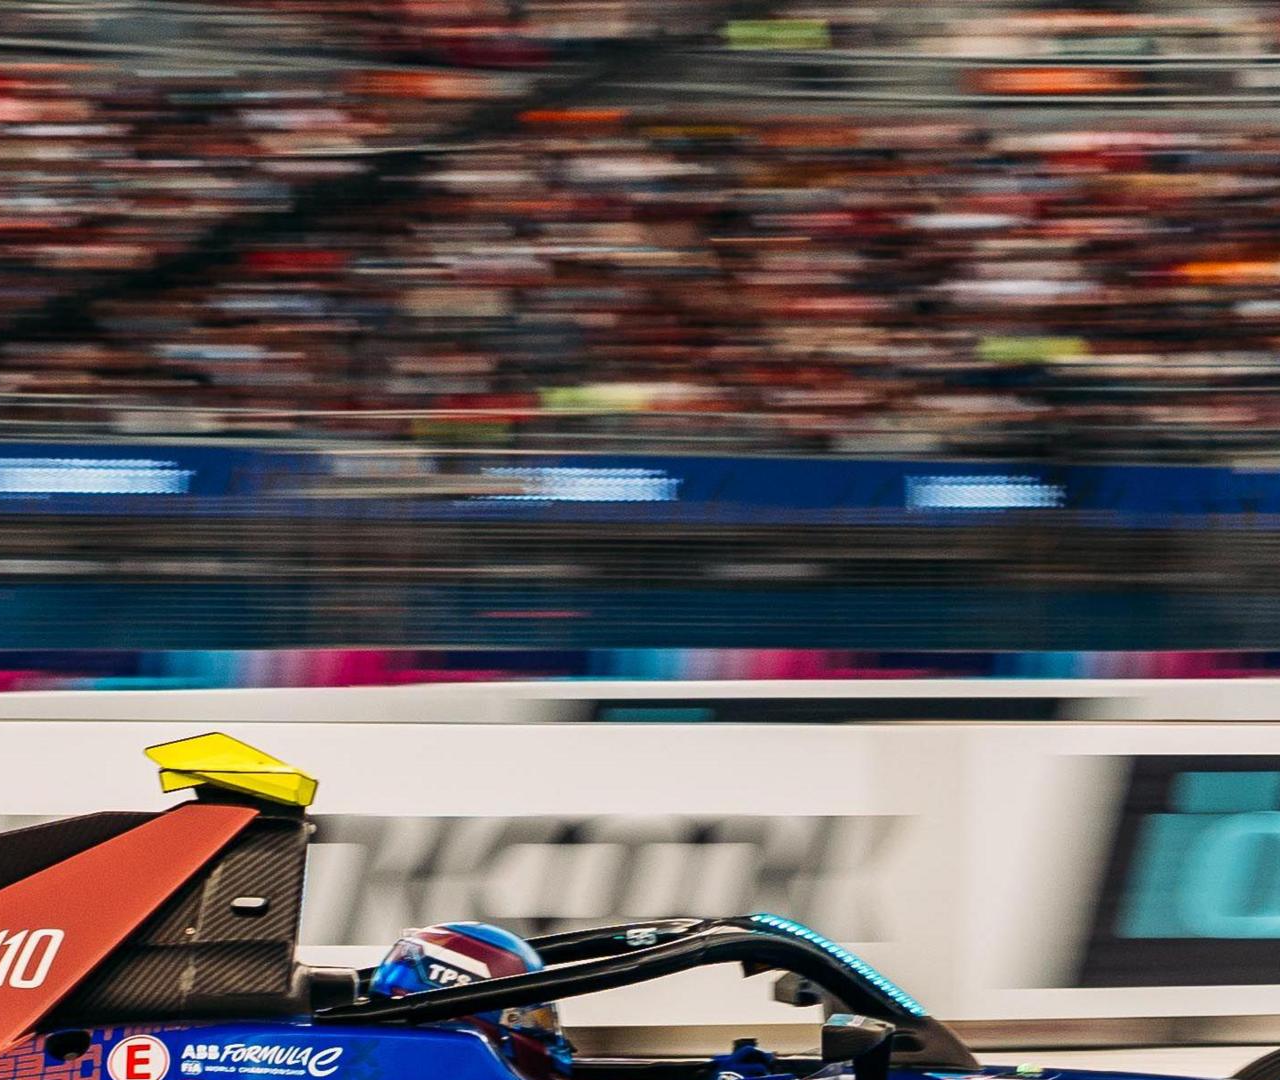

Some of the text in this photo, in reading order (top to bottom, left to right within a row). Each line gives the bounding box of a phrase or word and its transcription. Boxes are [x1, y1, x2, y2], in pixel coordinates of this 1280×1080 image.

[126, 1044, 151, 1080] E
[181, 1044, 220, 1060] ABB
[220, 1043, 310, 1066] FORMULA
